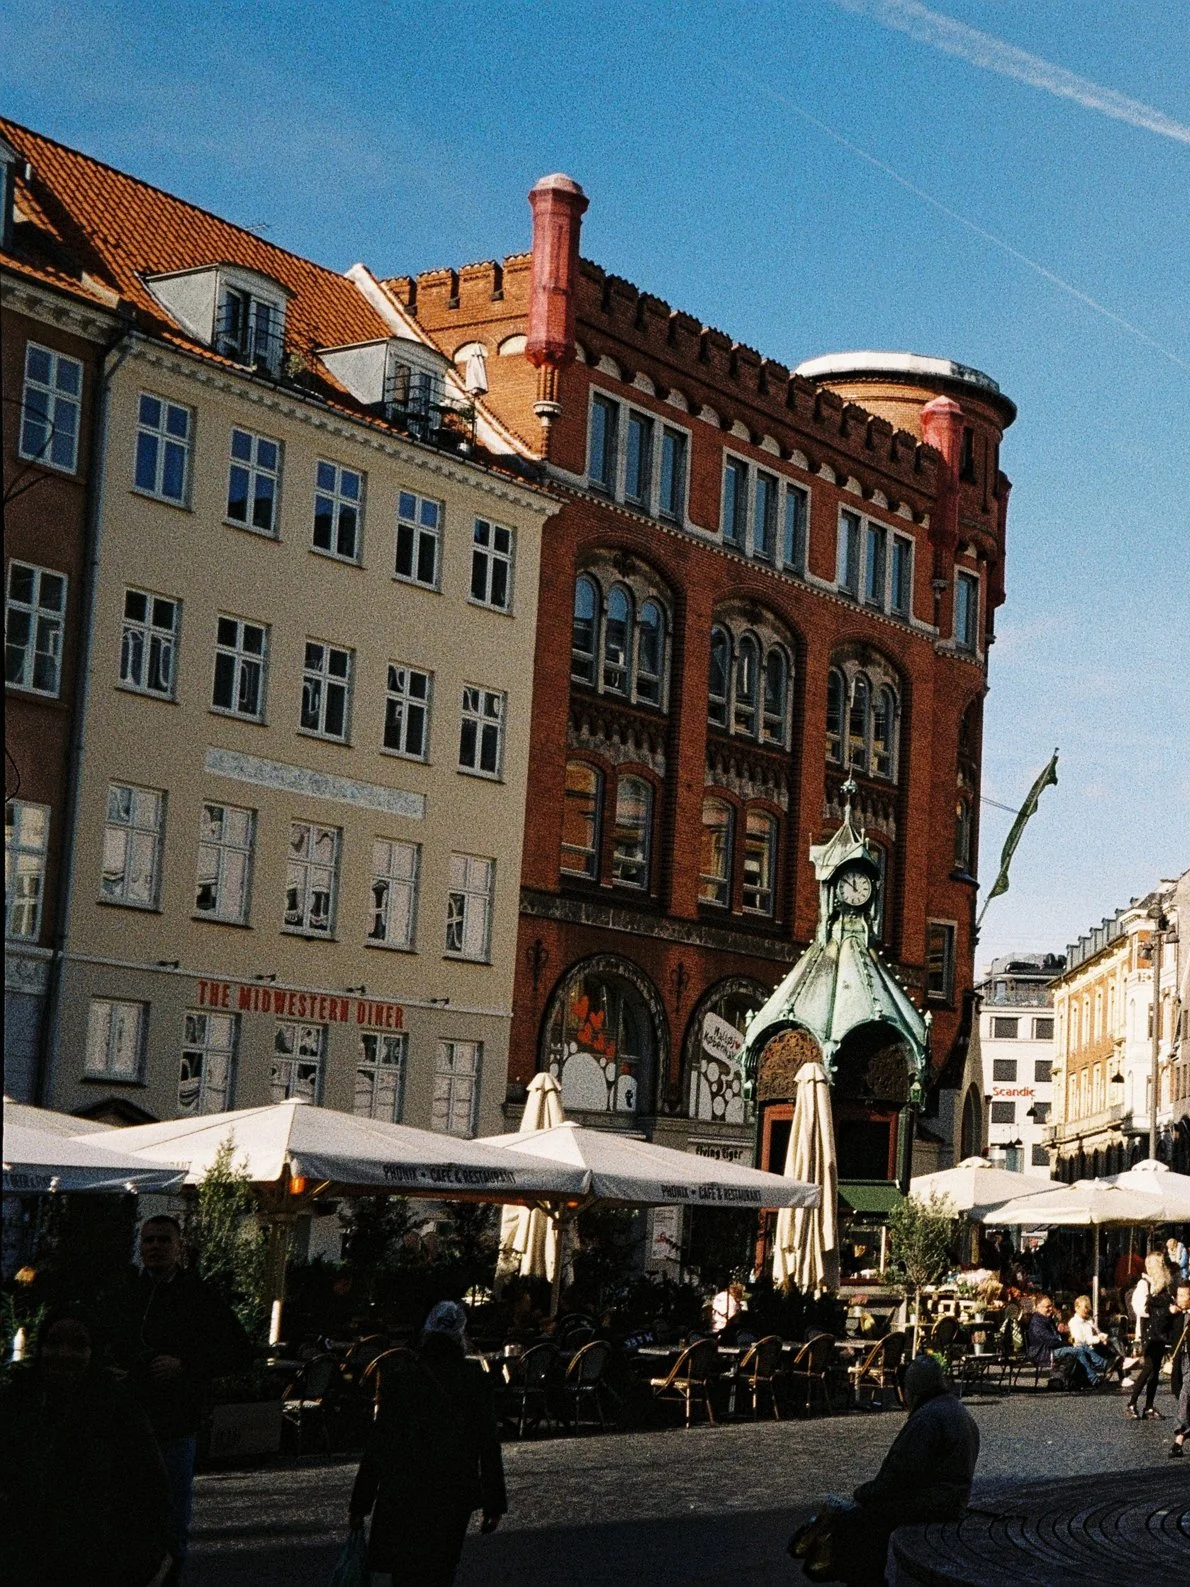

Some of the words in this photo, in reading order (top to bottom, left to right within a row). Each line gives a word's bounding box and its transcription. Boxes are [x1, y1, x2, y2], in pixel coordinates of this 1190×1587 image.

[198, 980, 230, 1008] THE
[237, 985, 349, 1023] MIDWESTERN
[356, 1001, 404, 1029] DINER
[992, 1087, 1036, 1097] Scandic
